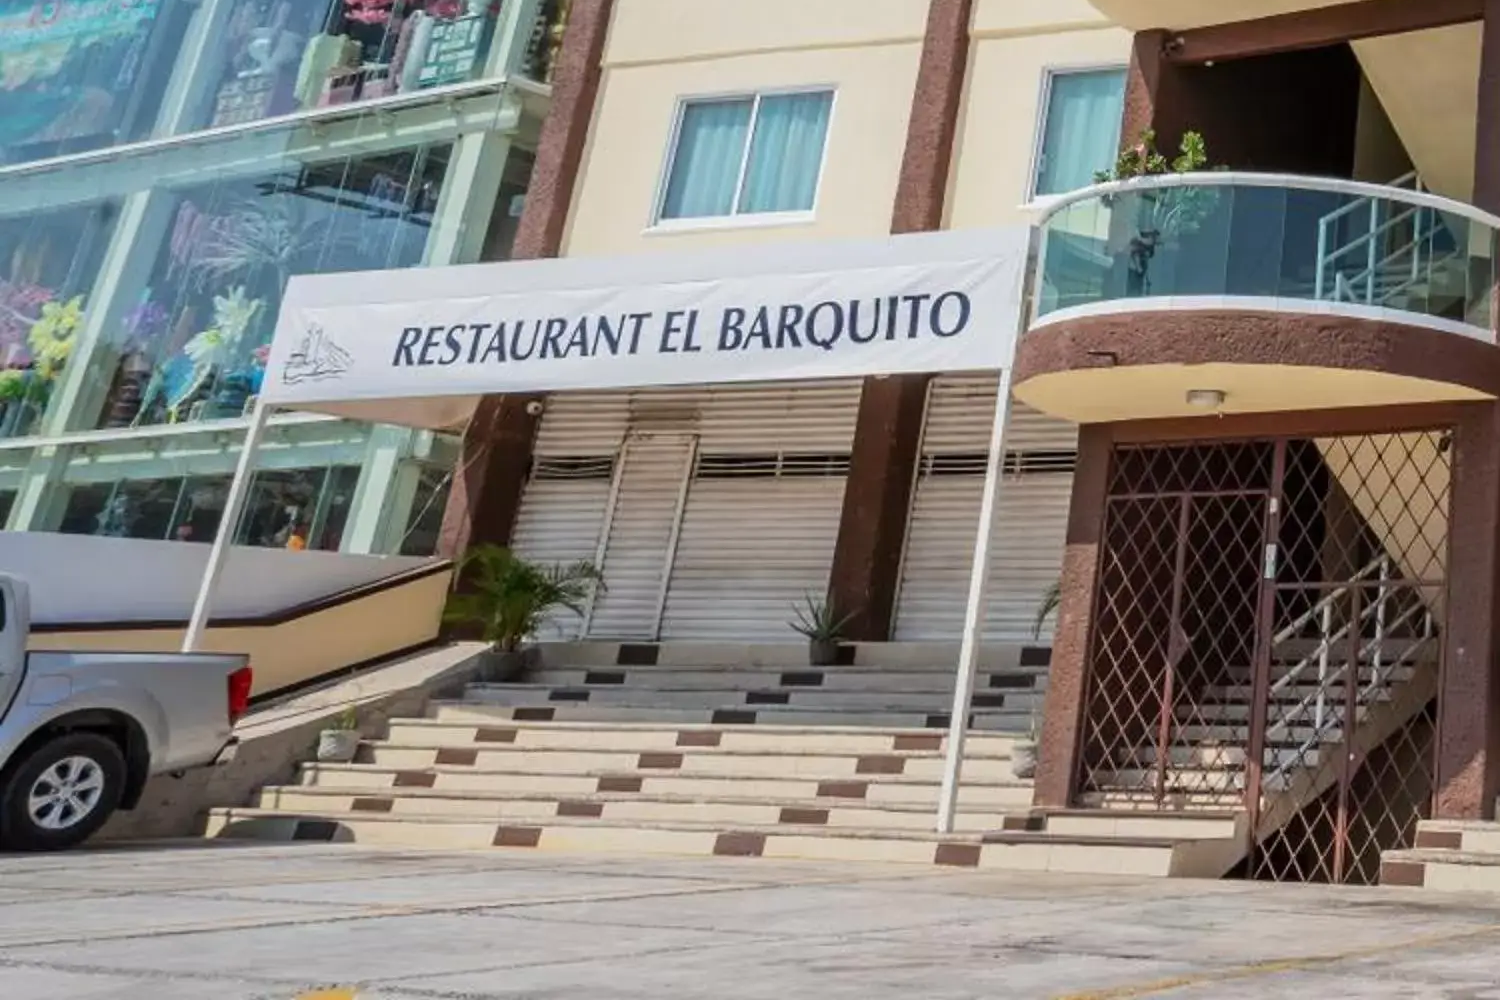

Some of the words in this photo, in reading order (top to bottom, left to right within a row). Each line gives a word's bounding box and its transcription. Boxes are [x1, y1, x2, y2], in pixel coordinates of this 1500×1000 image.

[392, 311, 651, 368] RESTAURANT
[660, 309, 703, 352] EL
[717, 291, 971, 352] BARQUITO
